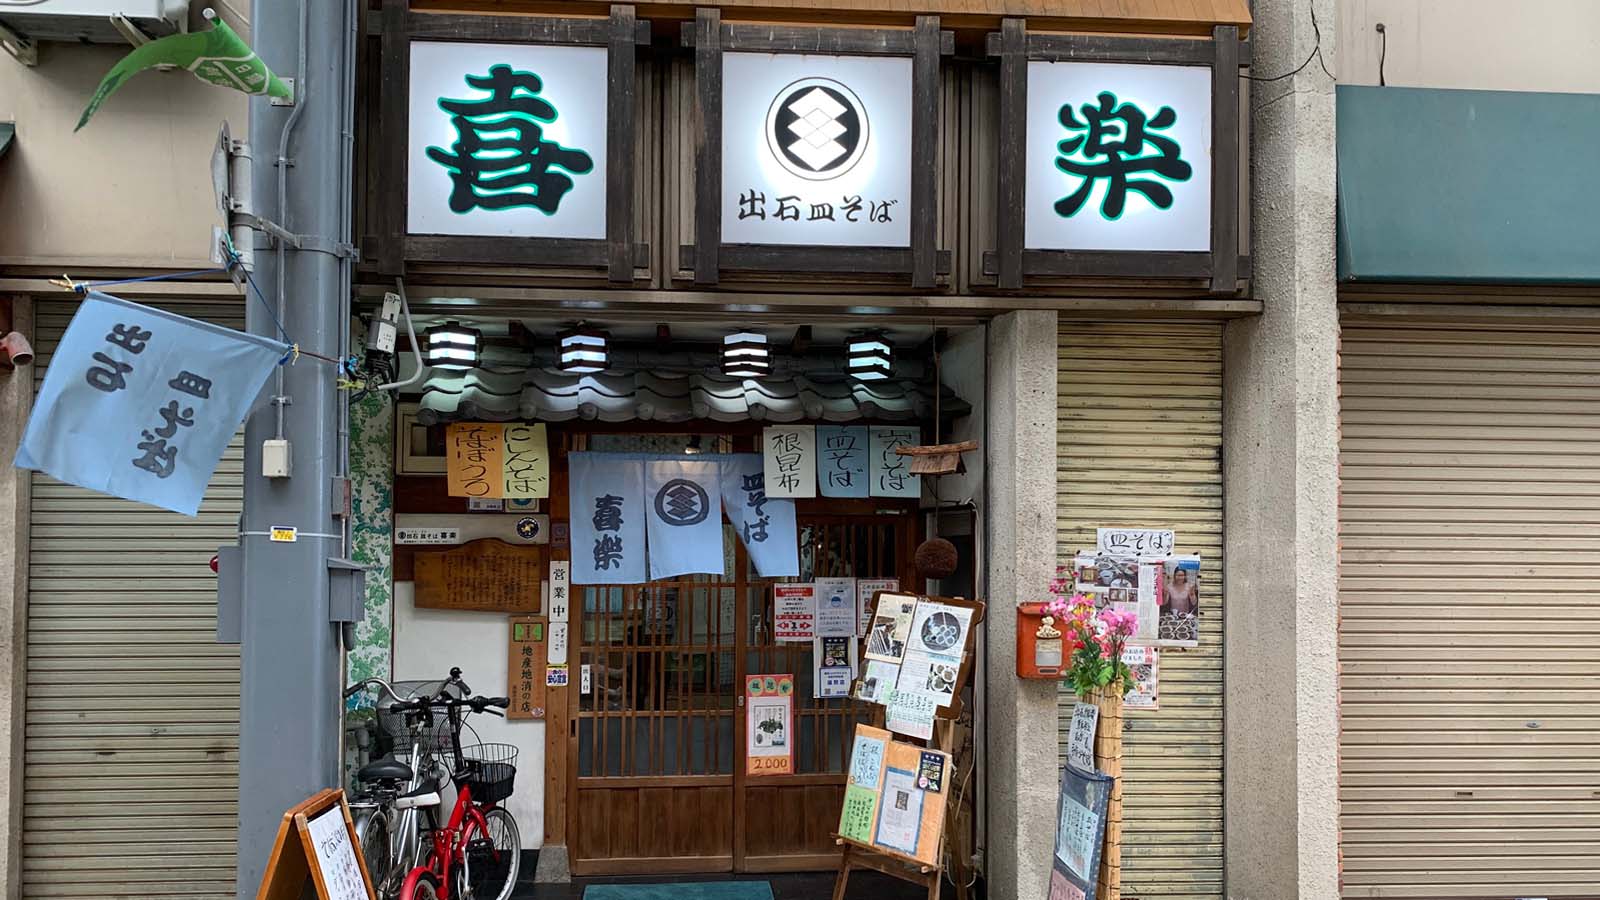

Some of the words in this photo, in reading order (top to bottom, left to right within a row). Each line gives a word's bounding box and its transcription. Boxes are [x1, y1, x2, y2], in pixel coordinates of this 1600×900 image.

[425, 63, 594, 216] 喜
[1053, 90, 1193, 221] 楽
[737, 188, 899, 223] 出石皿そば
[503, 426, 546, 494] にしんそば
[771, 432, 804, 493] 根昆布
[741, 472, 771, 545] 皿そば
[1110, 533, 1170, 550] 皿そば
[553, 568, 566, 618] 営業中
[521, 645, 534, 713] 地産地消の店
[753, 758, 788, 770] 2000
